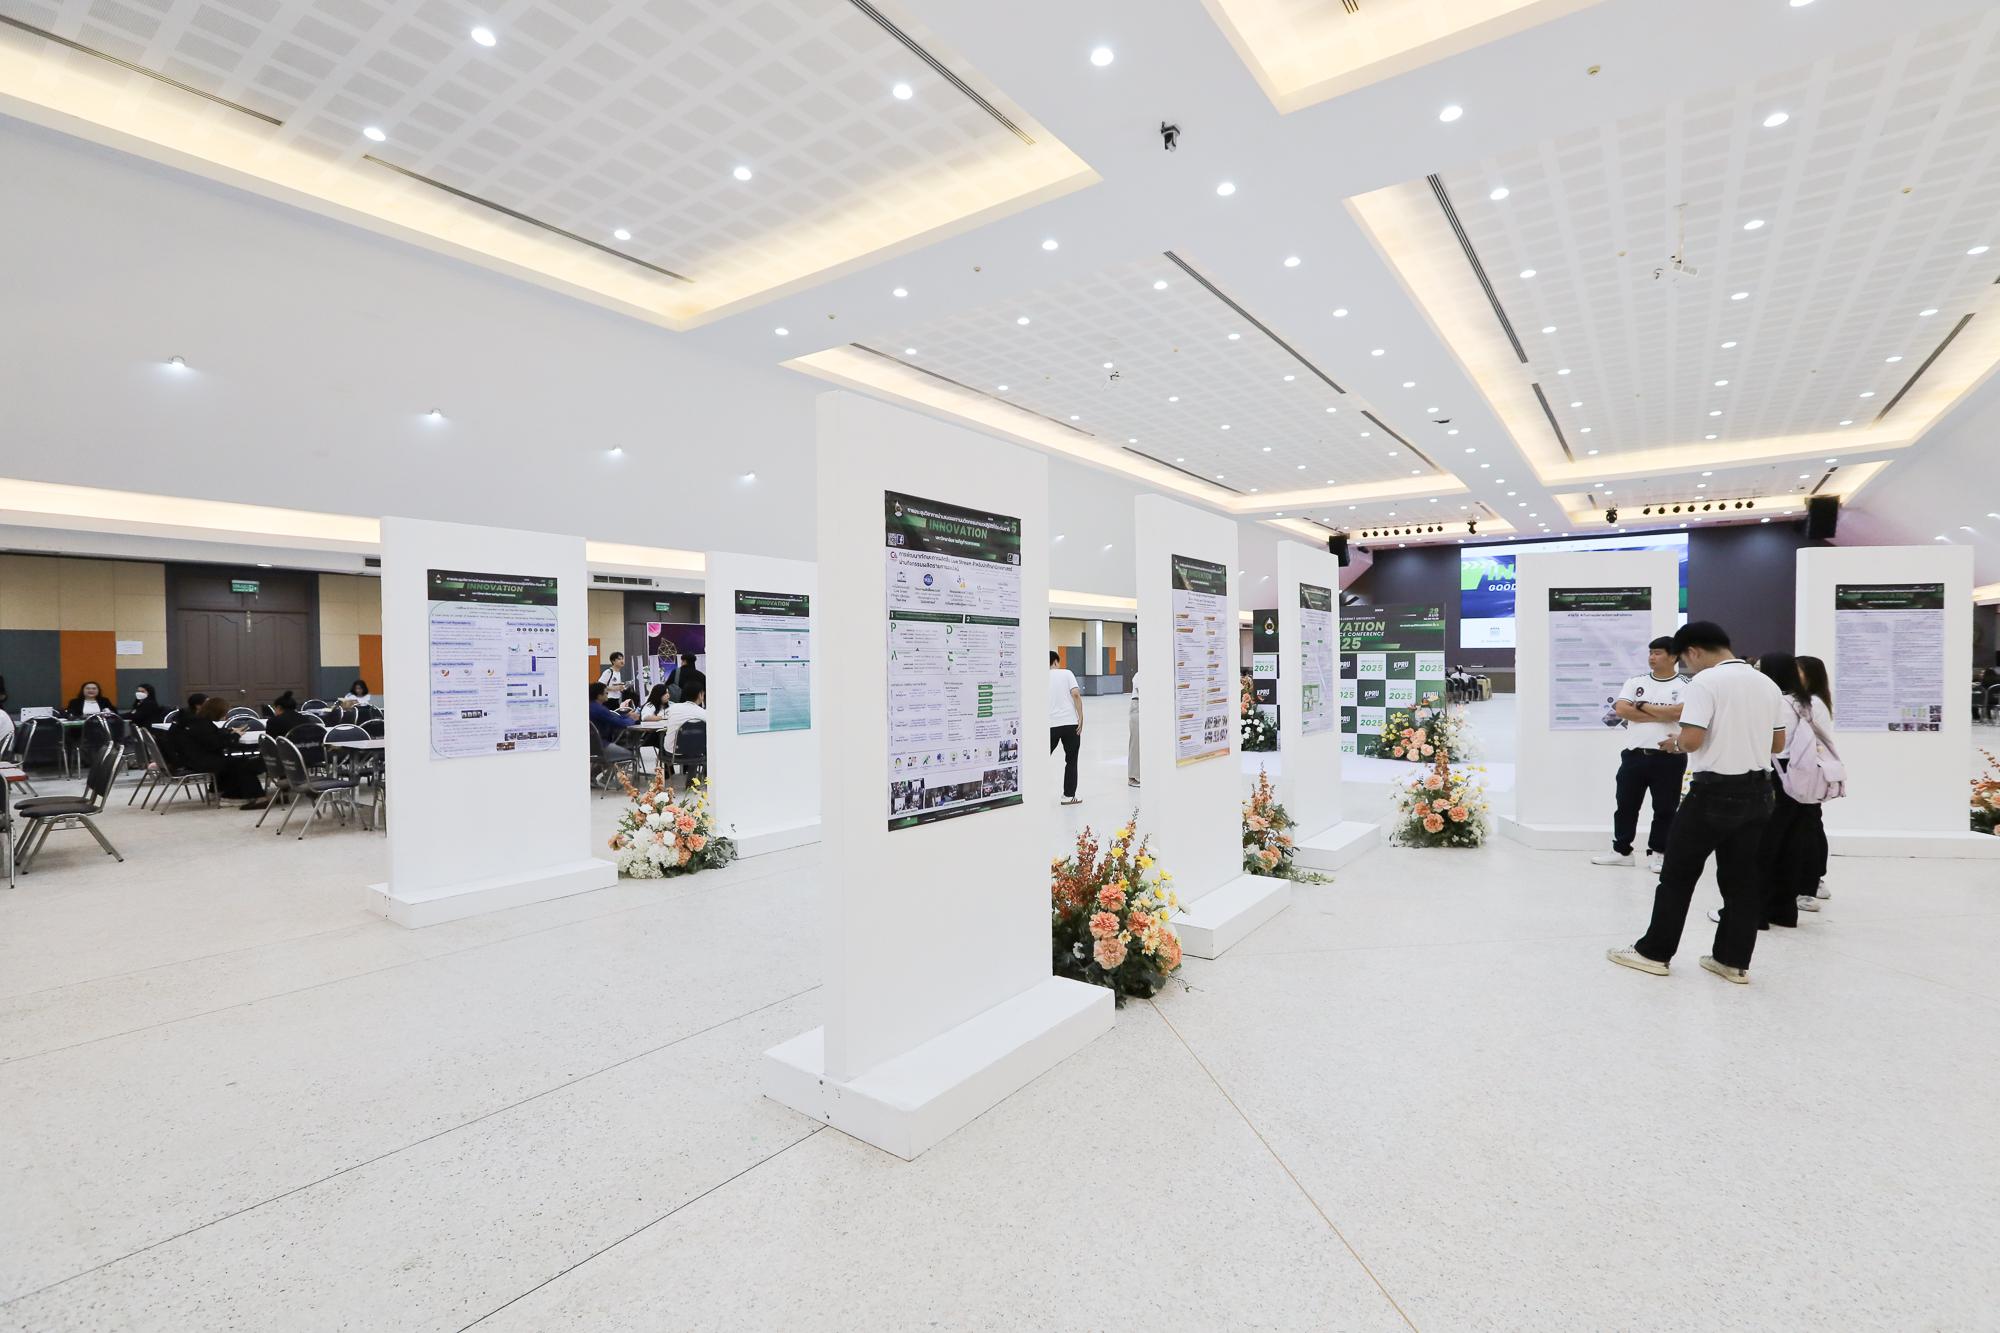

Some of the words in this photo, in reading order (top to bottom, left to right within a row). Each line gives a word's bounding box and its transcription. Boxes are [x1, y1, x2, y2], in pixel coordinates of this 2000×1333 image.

[928, 520, 988, 540] INNOVATION
[466, 582, 524, 593] INNOVATION
[1488, 583, 1517, 592] GOOD
[890, 622, 897, 633] P
[1254, 664, 1275, 672] 2025
[1360, 664, 1383, 672] 2025
[1393, 661, 1409, 669] KPRU
[1418, 664, 1444, 672] 2025
[1256, 688, 1270, 696] KPRU
[1364, 690, 1380, 698] KPRU
[1388, 692, 1412, 700] 2025
[1360, 719, 1383, 727] 2025
